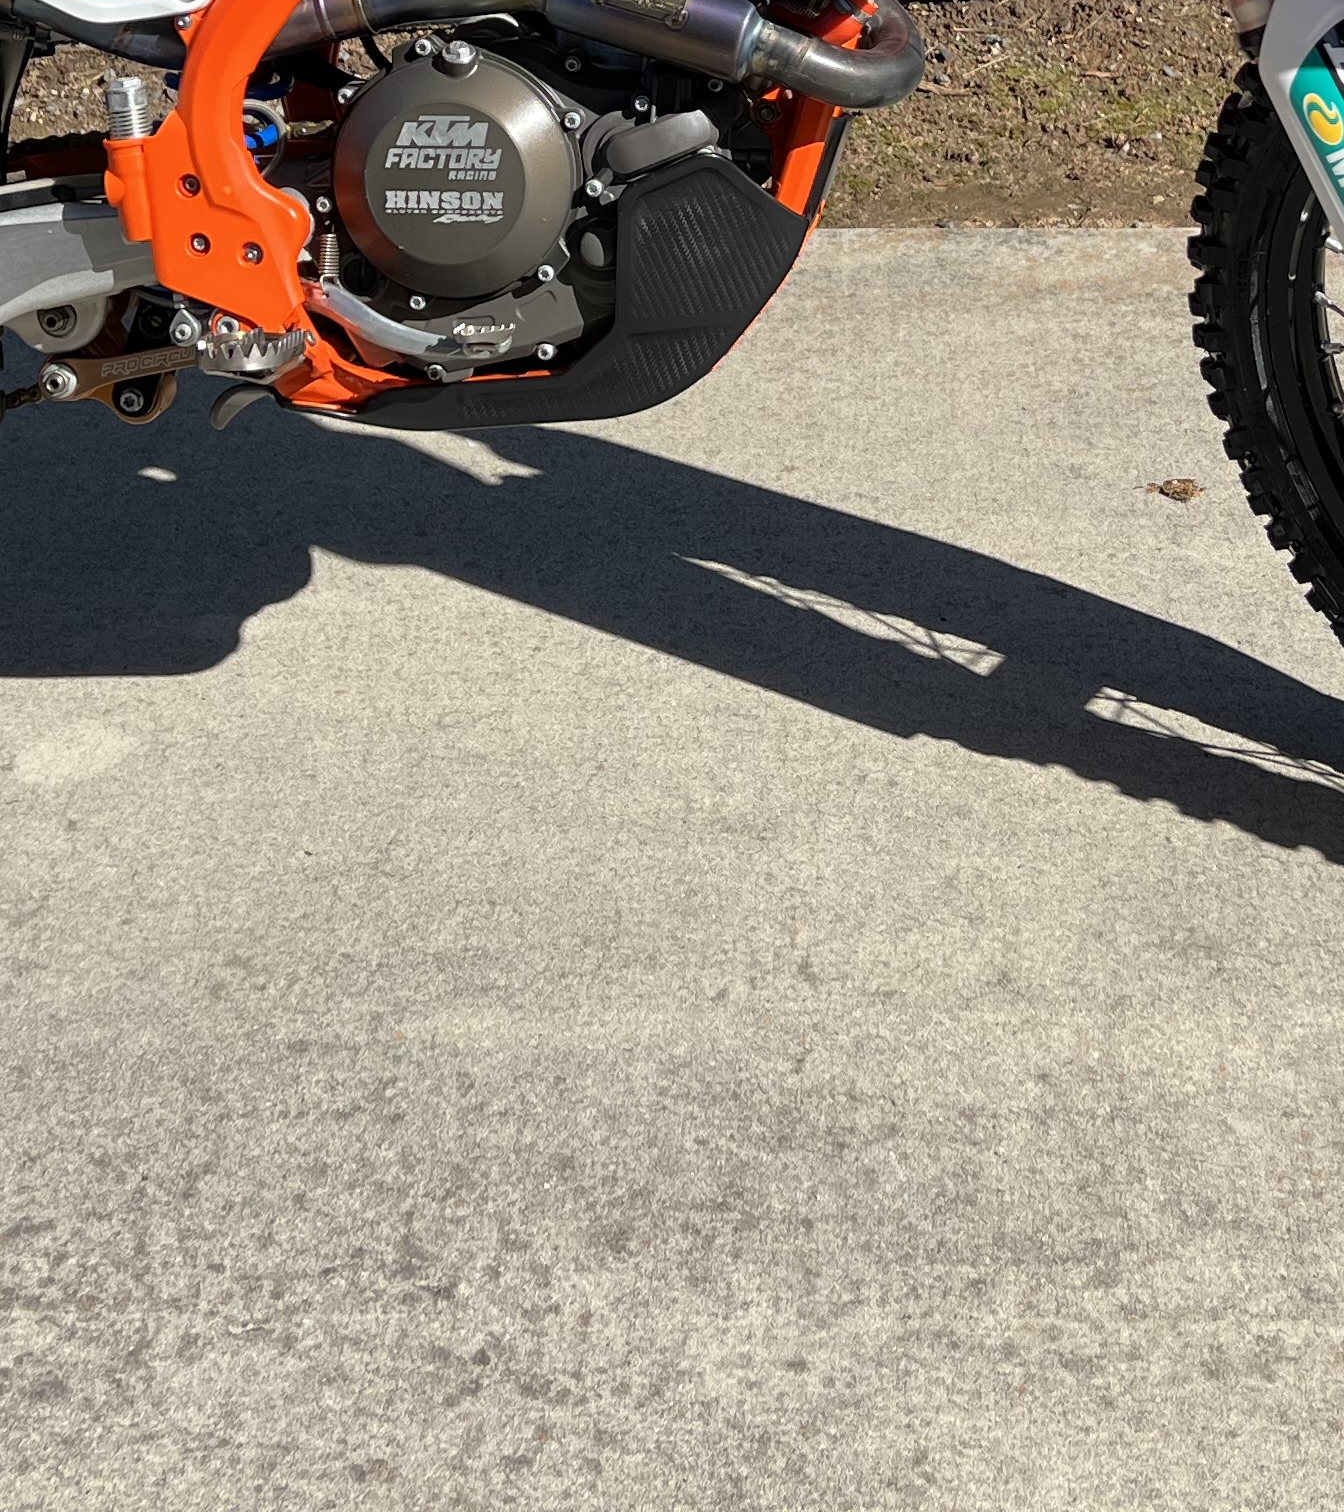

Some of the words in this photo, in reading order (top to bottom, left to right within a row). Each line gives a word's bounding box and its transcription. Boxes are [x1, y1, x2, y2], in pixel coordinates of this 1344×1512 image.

[395, 114, 489, 147] KTM
[384, 147, 503, 169] FACTORY
[448, 170, 497, 181] RACING
[384, 190, 504, 210] HINSON
[100, 360, 139, 377] PRO
